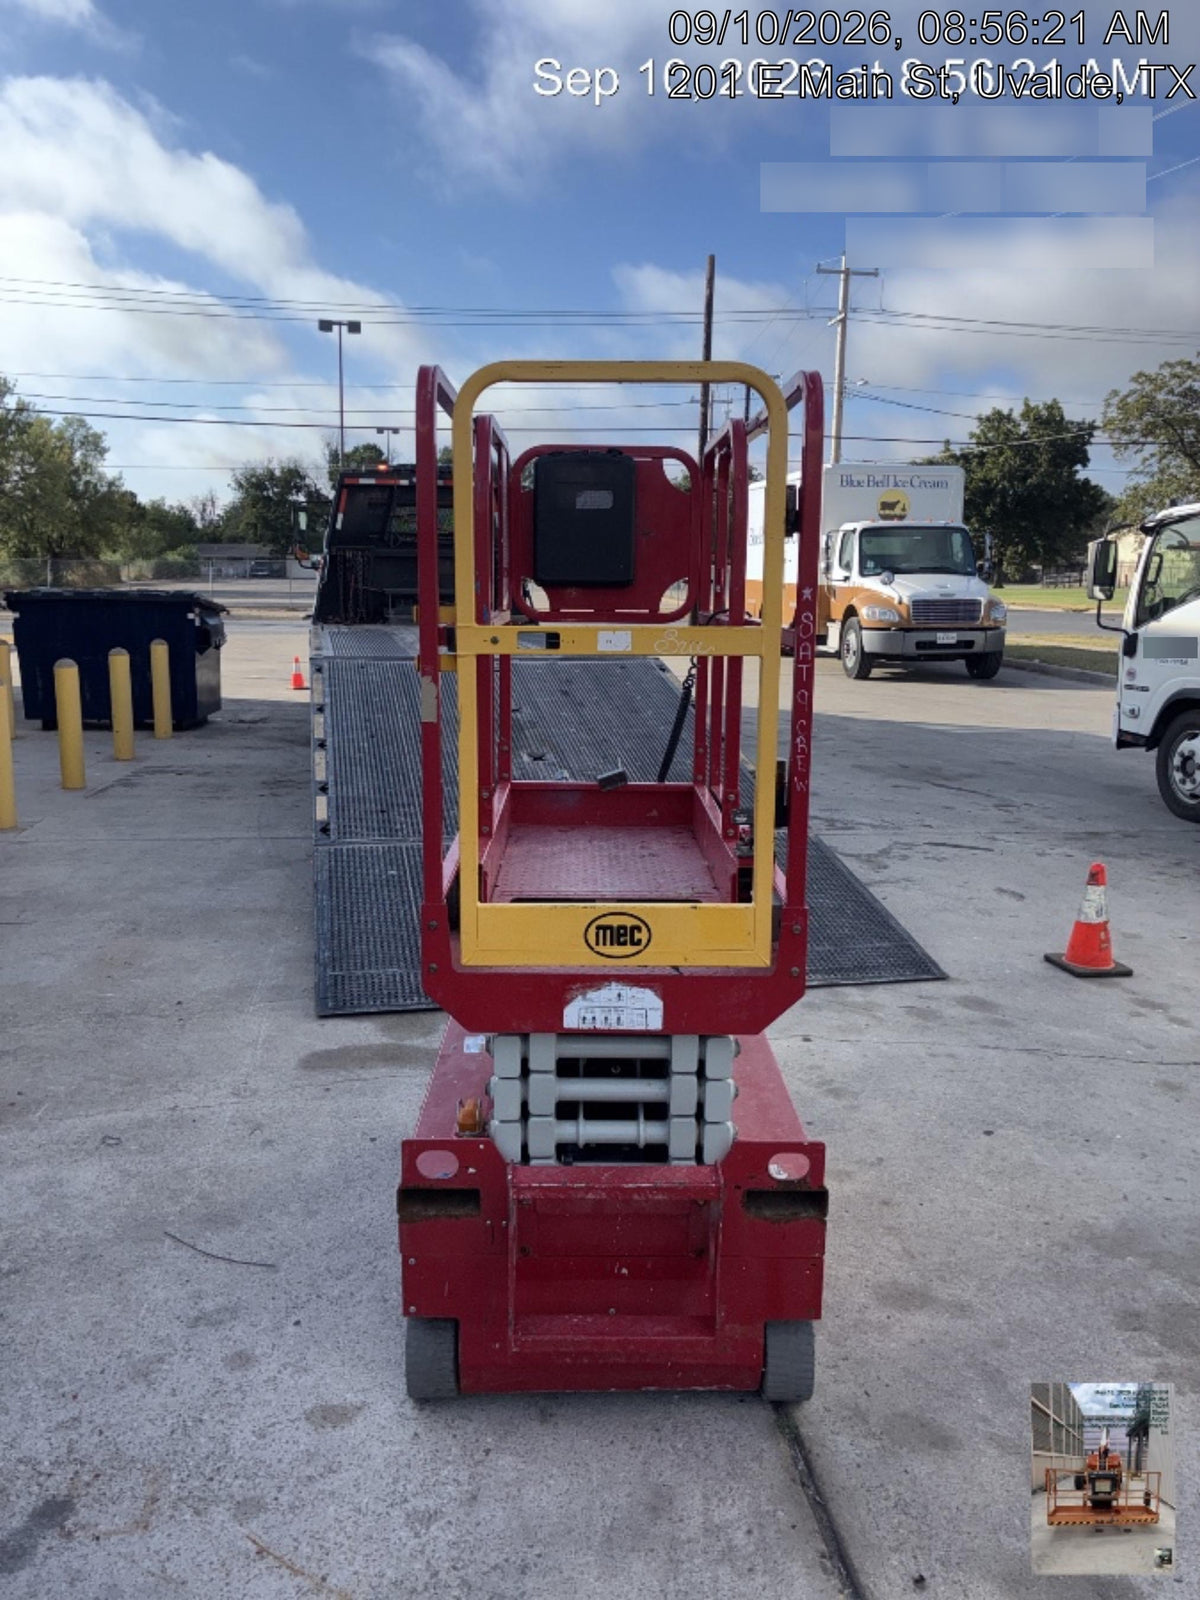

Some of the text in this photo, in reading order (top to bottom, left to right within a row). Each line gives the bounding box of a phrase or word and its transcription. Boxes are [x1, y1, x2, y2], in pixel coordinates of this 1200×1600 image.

[840, 474, 864, 488] Blue
[867, 474, 890, 488] Bell
[909, 475, 949, 489] Cream
